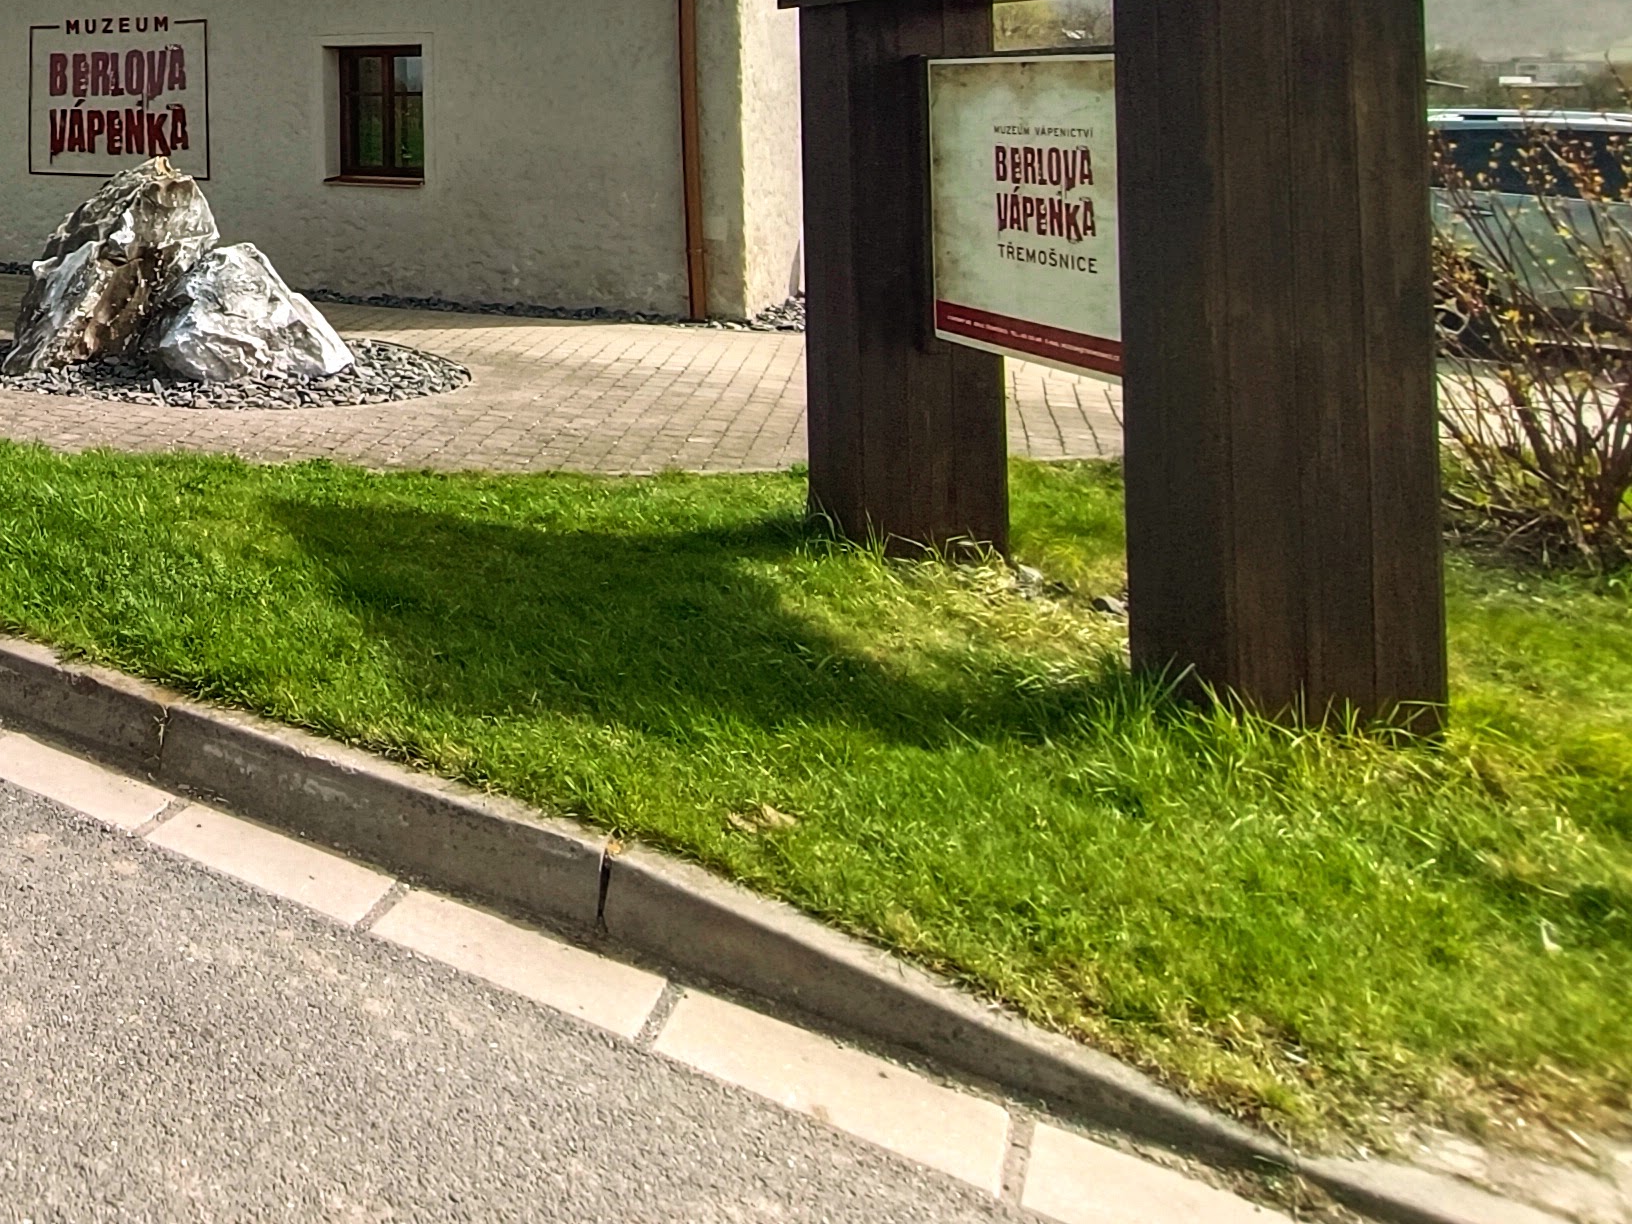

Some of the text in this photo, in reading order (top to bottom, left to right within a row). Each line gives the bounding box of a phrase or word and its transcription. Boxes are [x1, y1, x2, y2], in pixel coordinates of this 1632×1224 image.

[66, 16, 168, 34] MUZEUM
[50, 99, 189, 157] VÁPENKA
[994, 125, 1030, 136] MUZEUM
[995, 145, 1094, 191] BERLOVA
[996, 186, 1096, 243] VÁPENKA
[997, 241, 1098, 274] TŘEMOŠNICE
